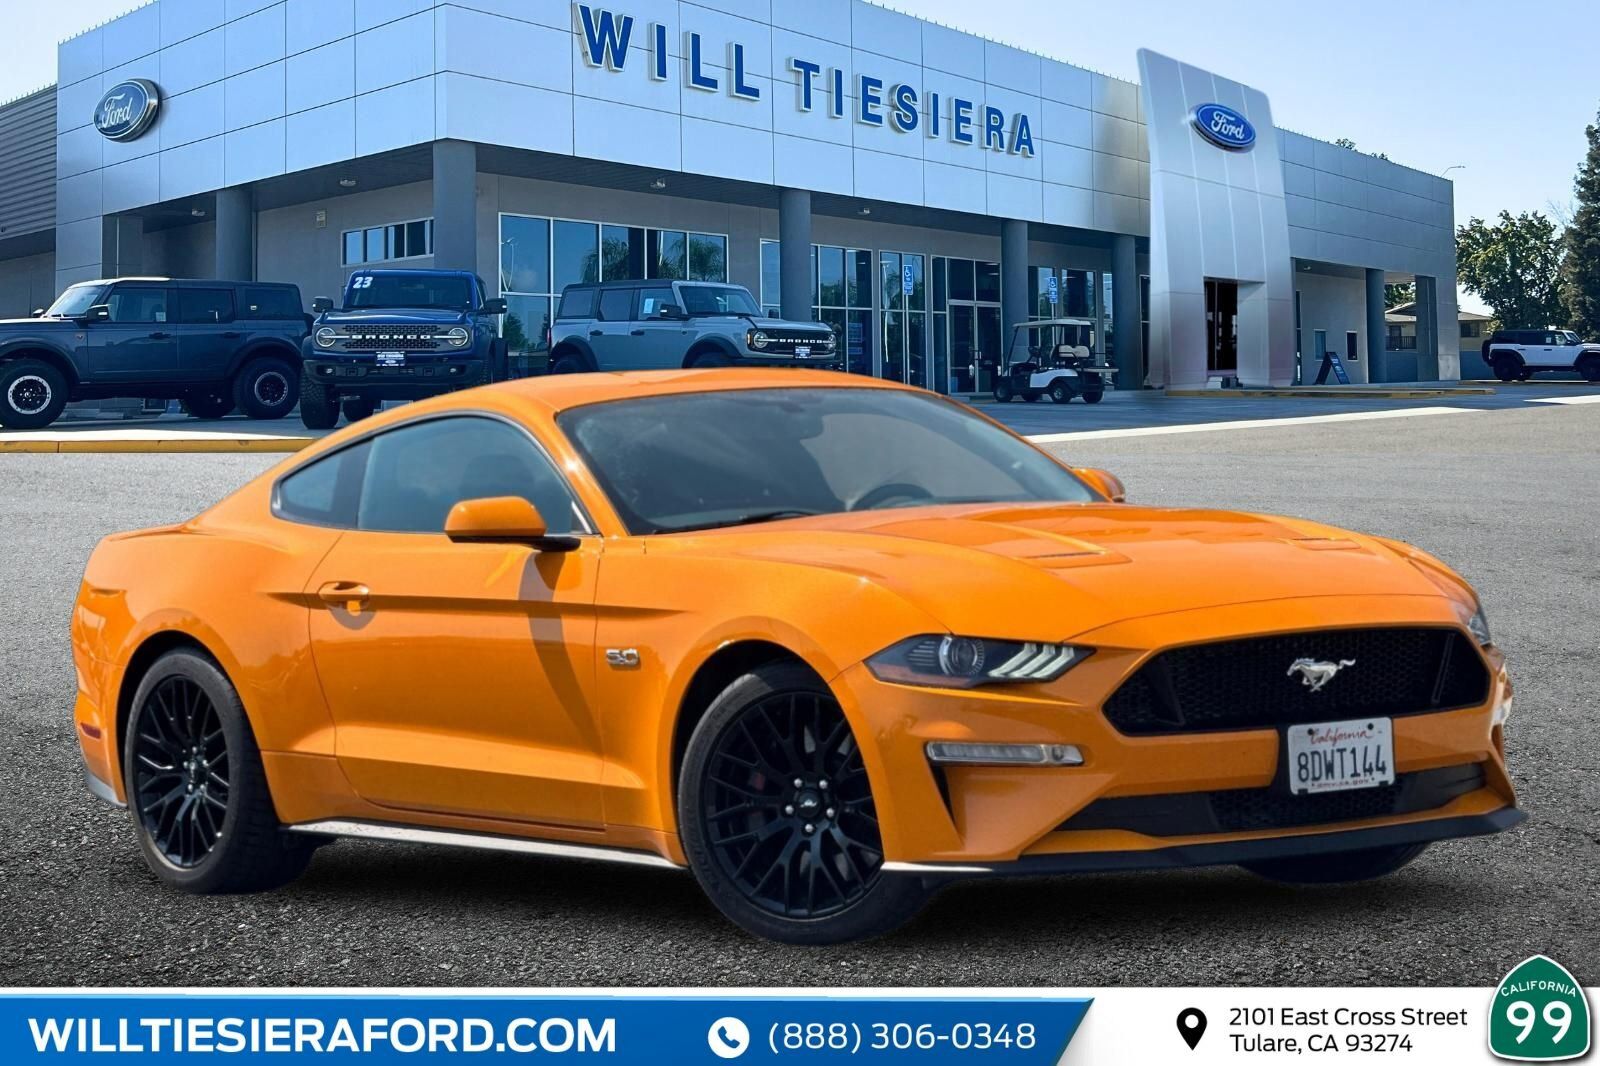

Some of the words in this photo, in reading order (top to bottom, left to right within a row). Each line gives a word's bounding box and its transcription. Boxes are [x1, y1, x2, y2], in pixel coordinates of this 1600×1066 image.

[574, 1, 760, 100] WILL
[788, 57, 1037, 157] TIESIERA
[101, 93, 134, 129] Ford
[1210, 110, 1245, 140] Ford
[352, 276, 373, 289] 23
[1297, 744, 1387, 783] 8DWT144
